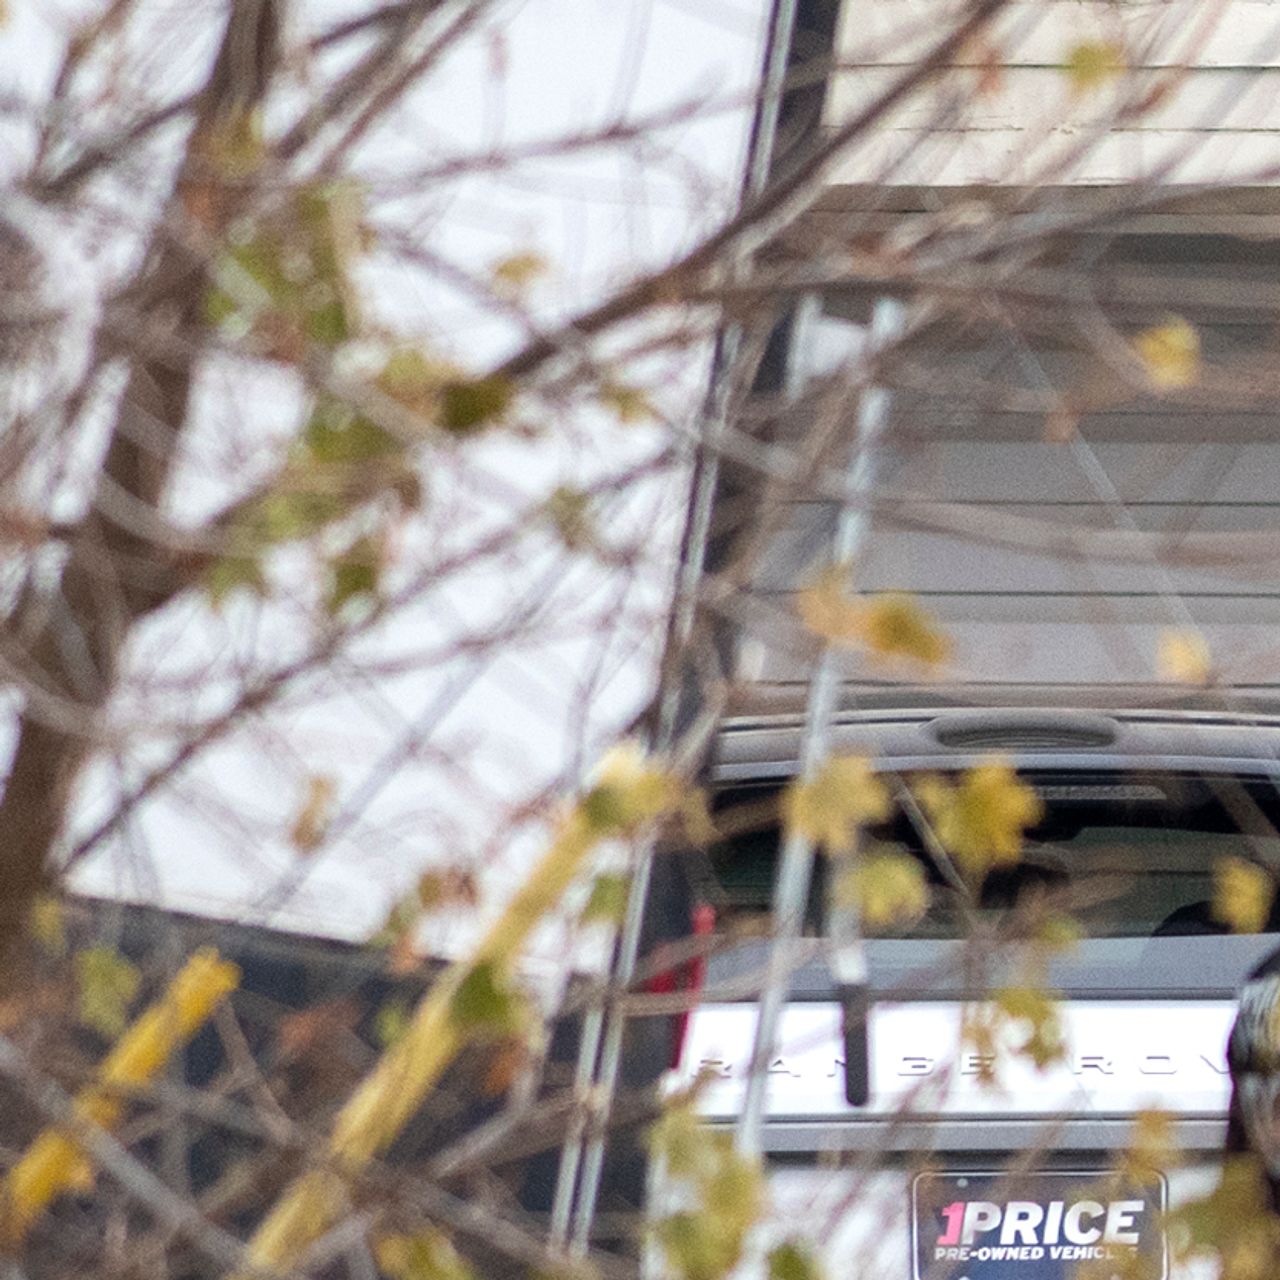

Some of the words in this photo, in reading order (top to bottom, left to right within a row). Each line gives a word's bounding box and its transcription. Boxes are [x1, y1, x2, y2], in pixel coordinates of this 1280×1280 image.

[937, 1200, 1145, 1246] 1PRICE
[935, 1246, 1044, 1261] PRE-OWNED
[1050, 1246, 1138, 1261] VEHICLS
